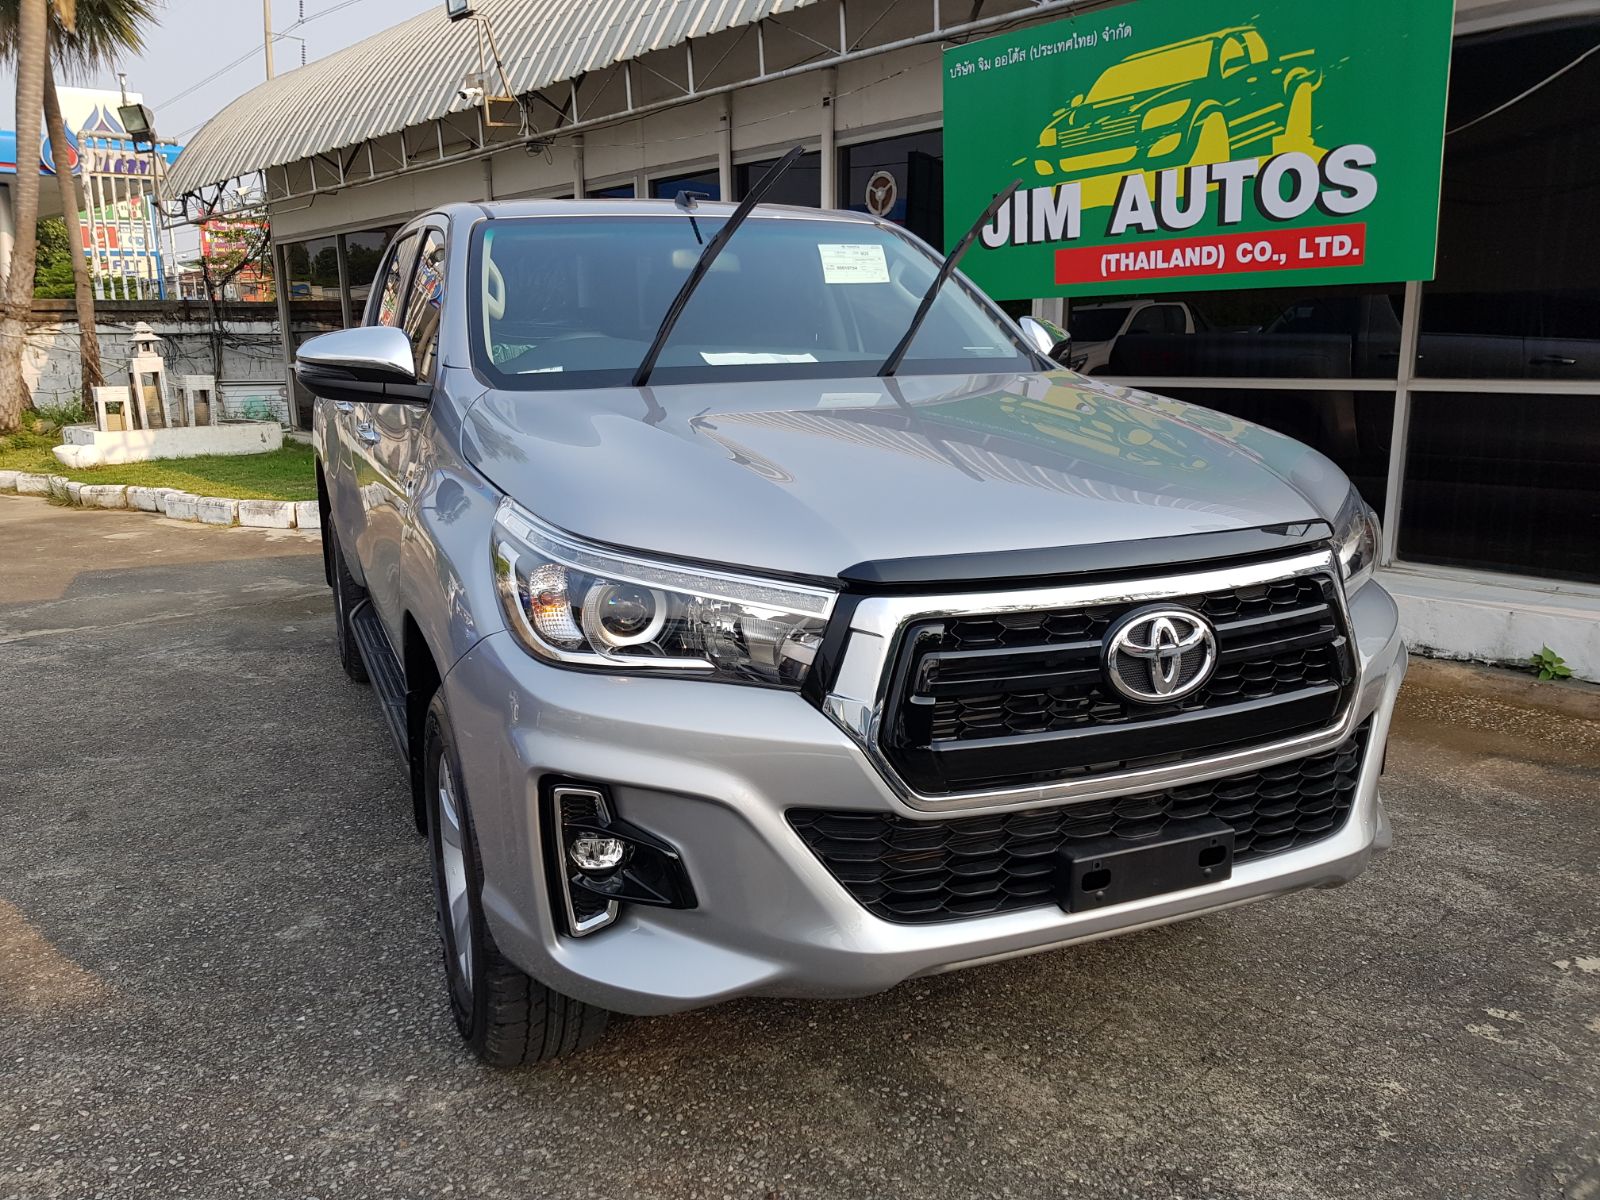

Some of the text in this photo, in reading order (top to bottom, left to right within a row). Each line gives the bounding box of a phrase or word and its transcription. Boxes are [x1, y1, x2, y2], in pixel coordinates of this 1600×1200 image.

[950, 22, 1132, 78] บริษัท จิม ออโต้ส (ประเทศไทย) จำกัด
[981, 143, 1378, 248] JIM AUTOS
[1101, 235, 1360, 277] (THAILAND) CO., LTD.
